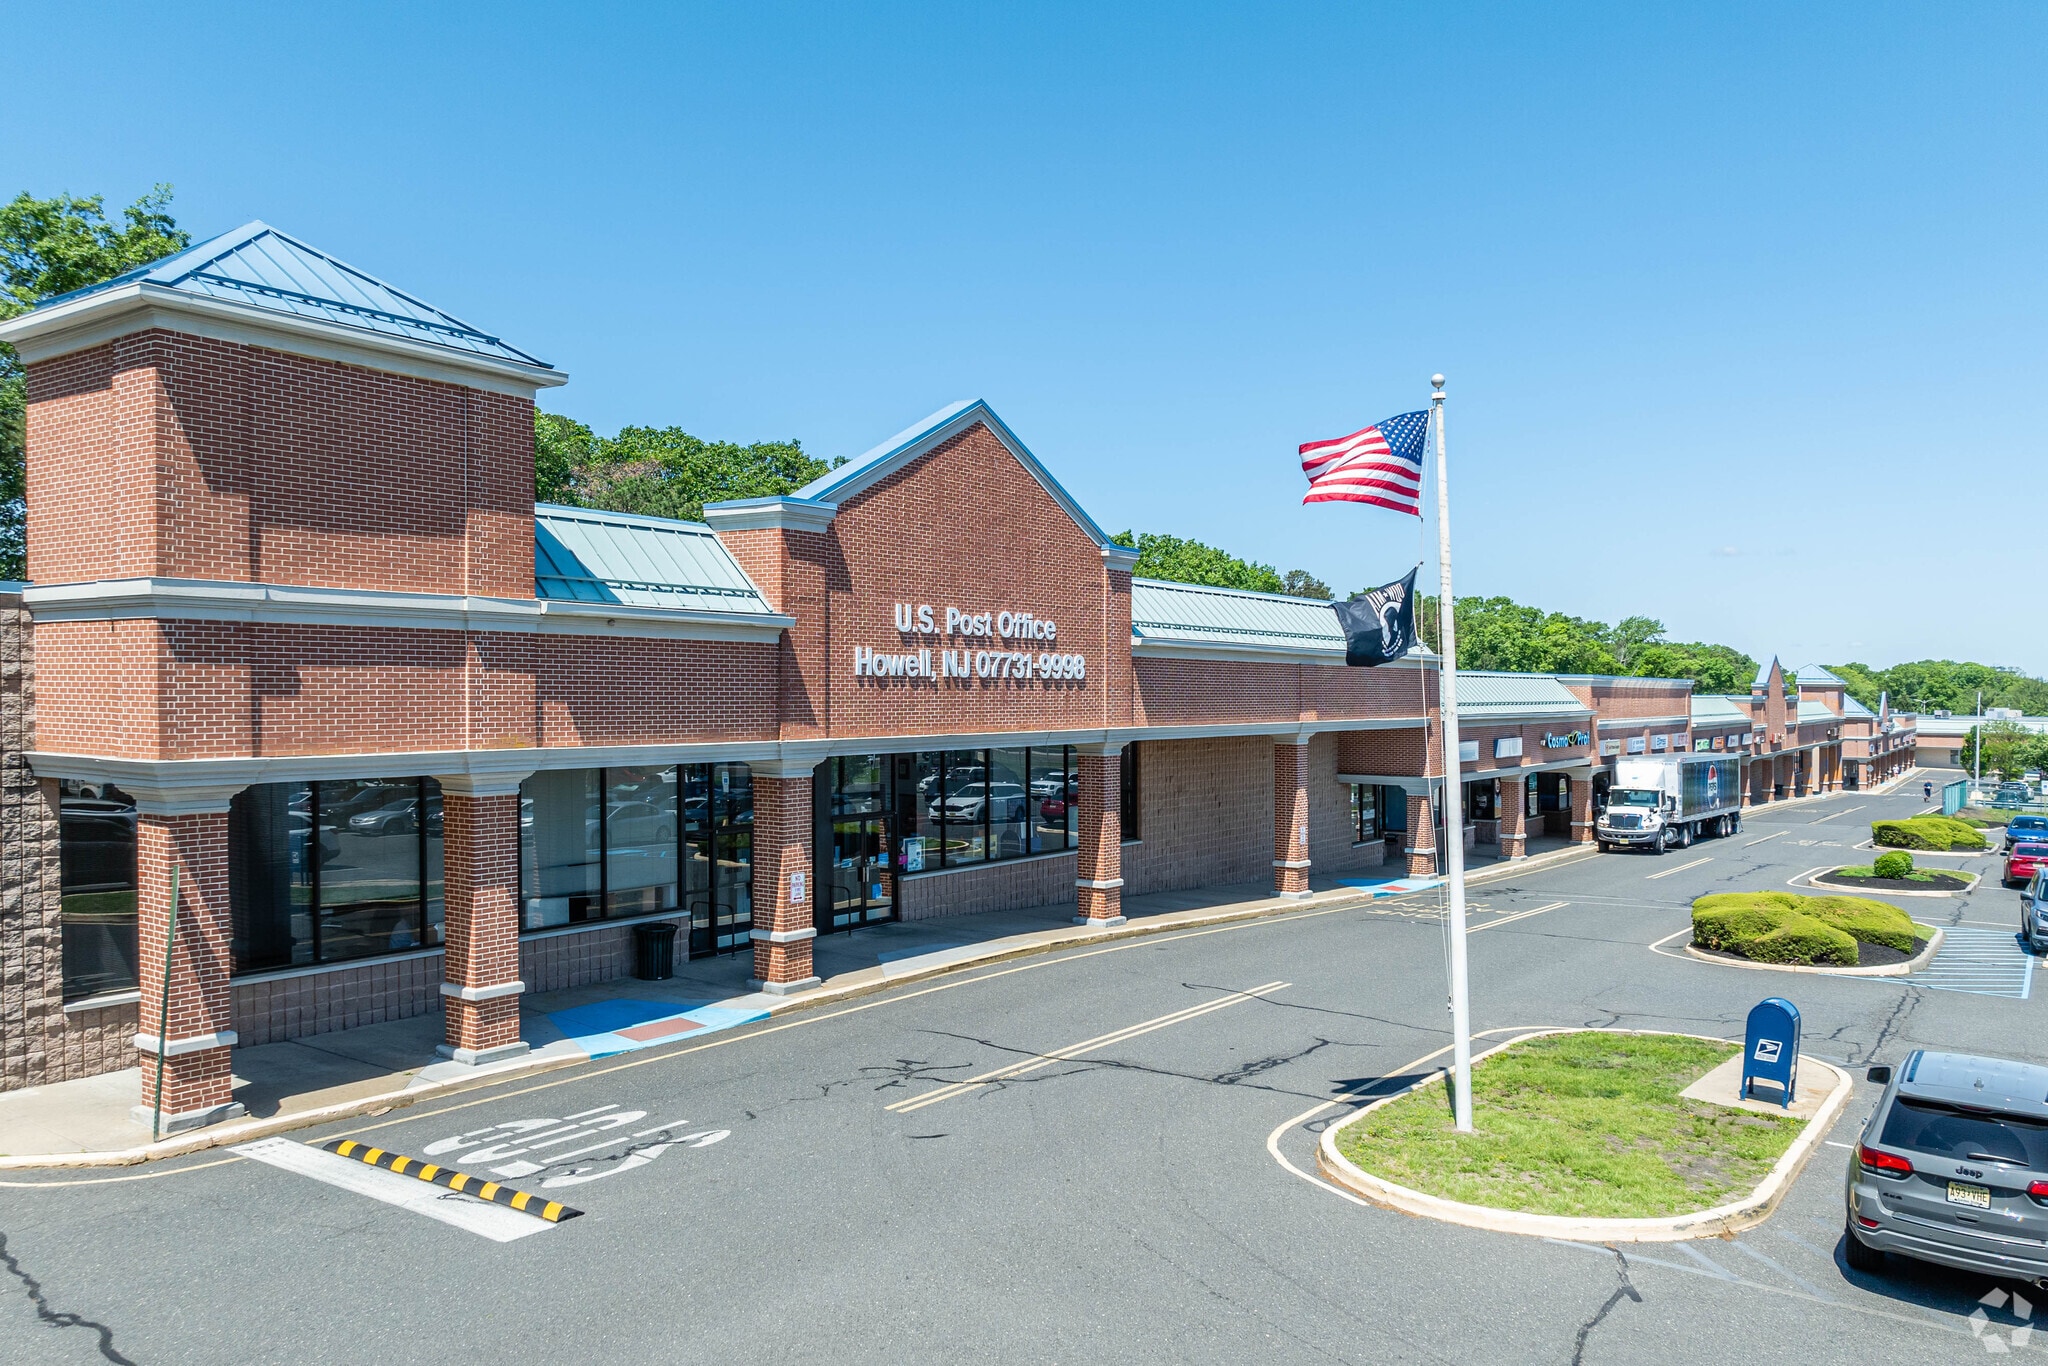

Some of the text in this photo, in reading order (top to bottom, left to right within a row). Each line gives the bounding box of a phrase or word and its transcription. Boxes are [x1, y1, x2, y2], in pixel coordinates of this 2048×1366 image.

[896, 603, 1056, 640] U.S. Post Office
[855, 646, 1085, 682] Howell, NJ 07731-9998
[1547, 731, 1569, 749] Cosmo
[423, 1104, 731, 1188] STOP
[1955, 1166, 1983, 1179] Jeep
